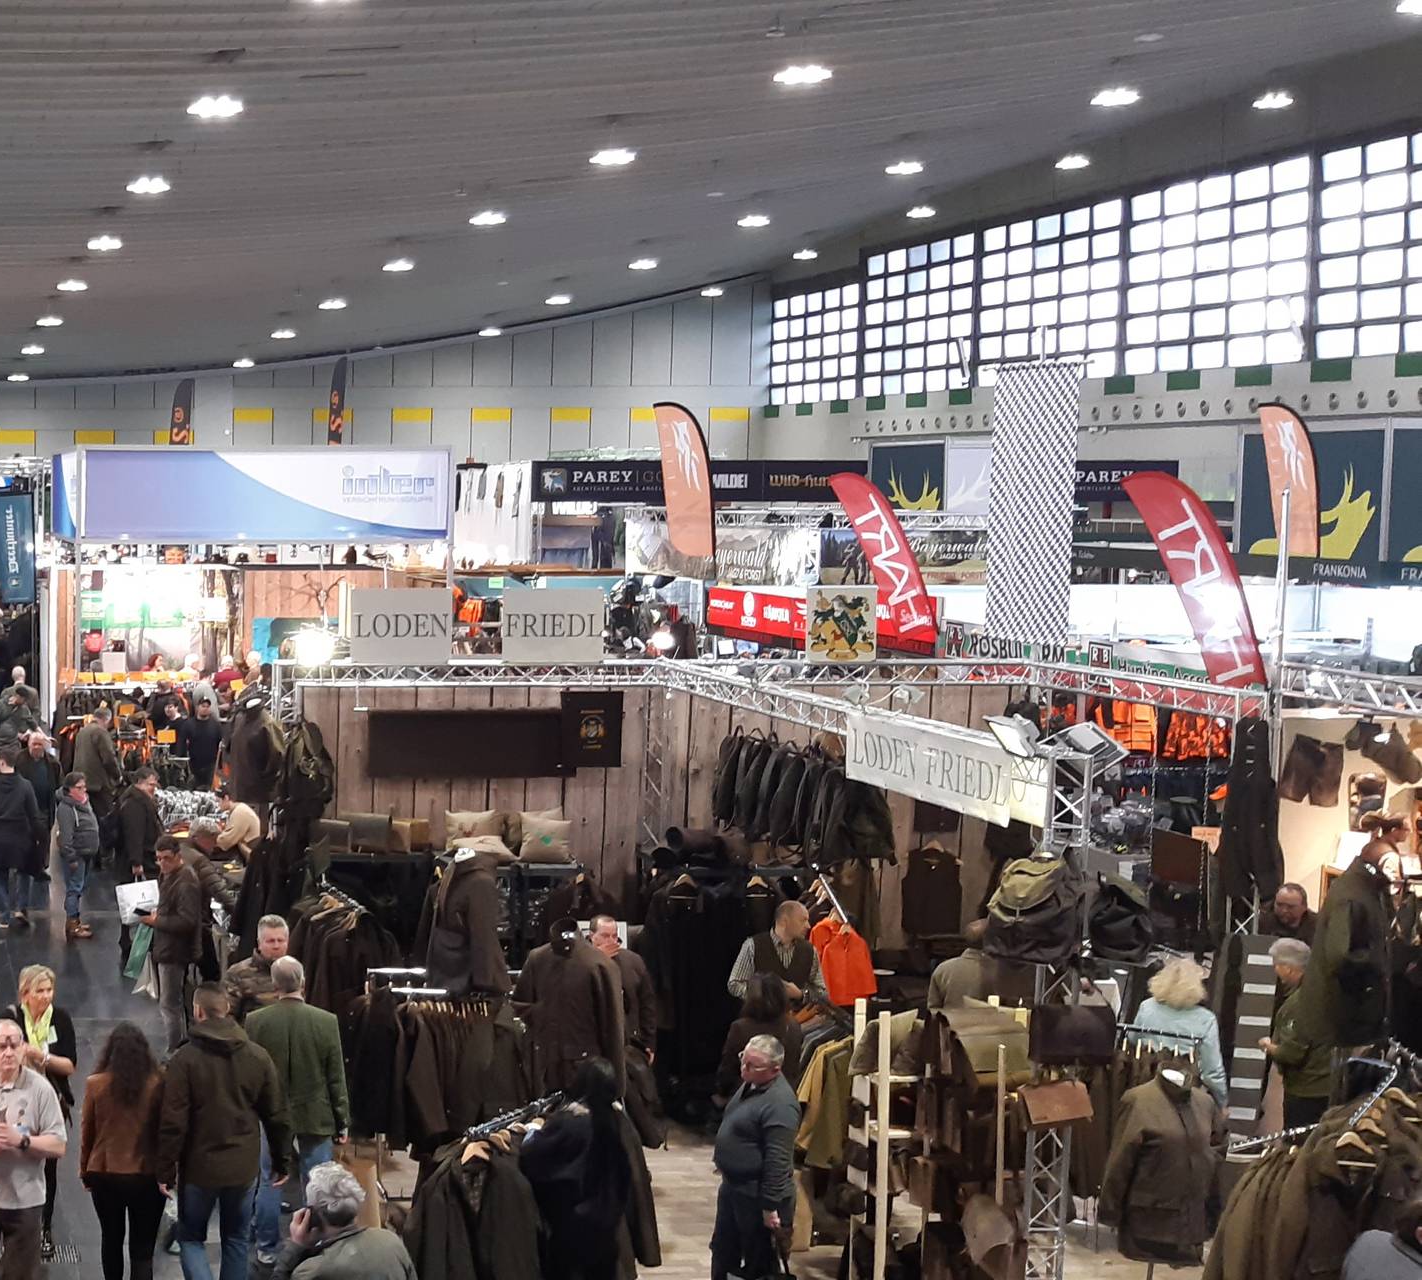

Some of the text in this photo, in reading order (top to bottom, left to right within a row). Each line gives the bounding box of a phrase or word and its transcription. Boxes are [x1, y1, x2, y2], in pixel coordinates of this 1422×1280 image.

[342, 465, 435, 495] inter
[572, 470, 633, 483] PAREY
[1312, 562, 1367, 579] FRANKONIA
[354, 612, 449, 639] LODEN
[505, 612, 603, 639] FRIEDL
[852, 727, 919, 781] LODEN
[926, 746, 1008, 807] FRIEDL
